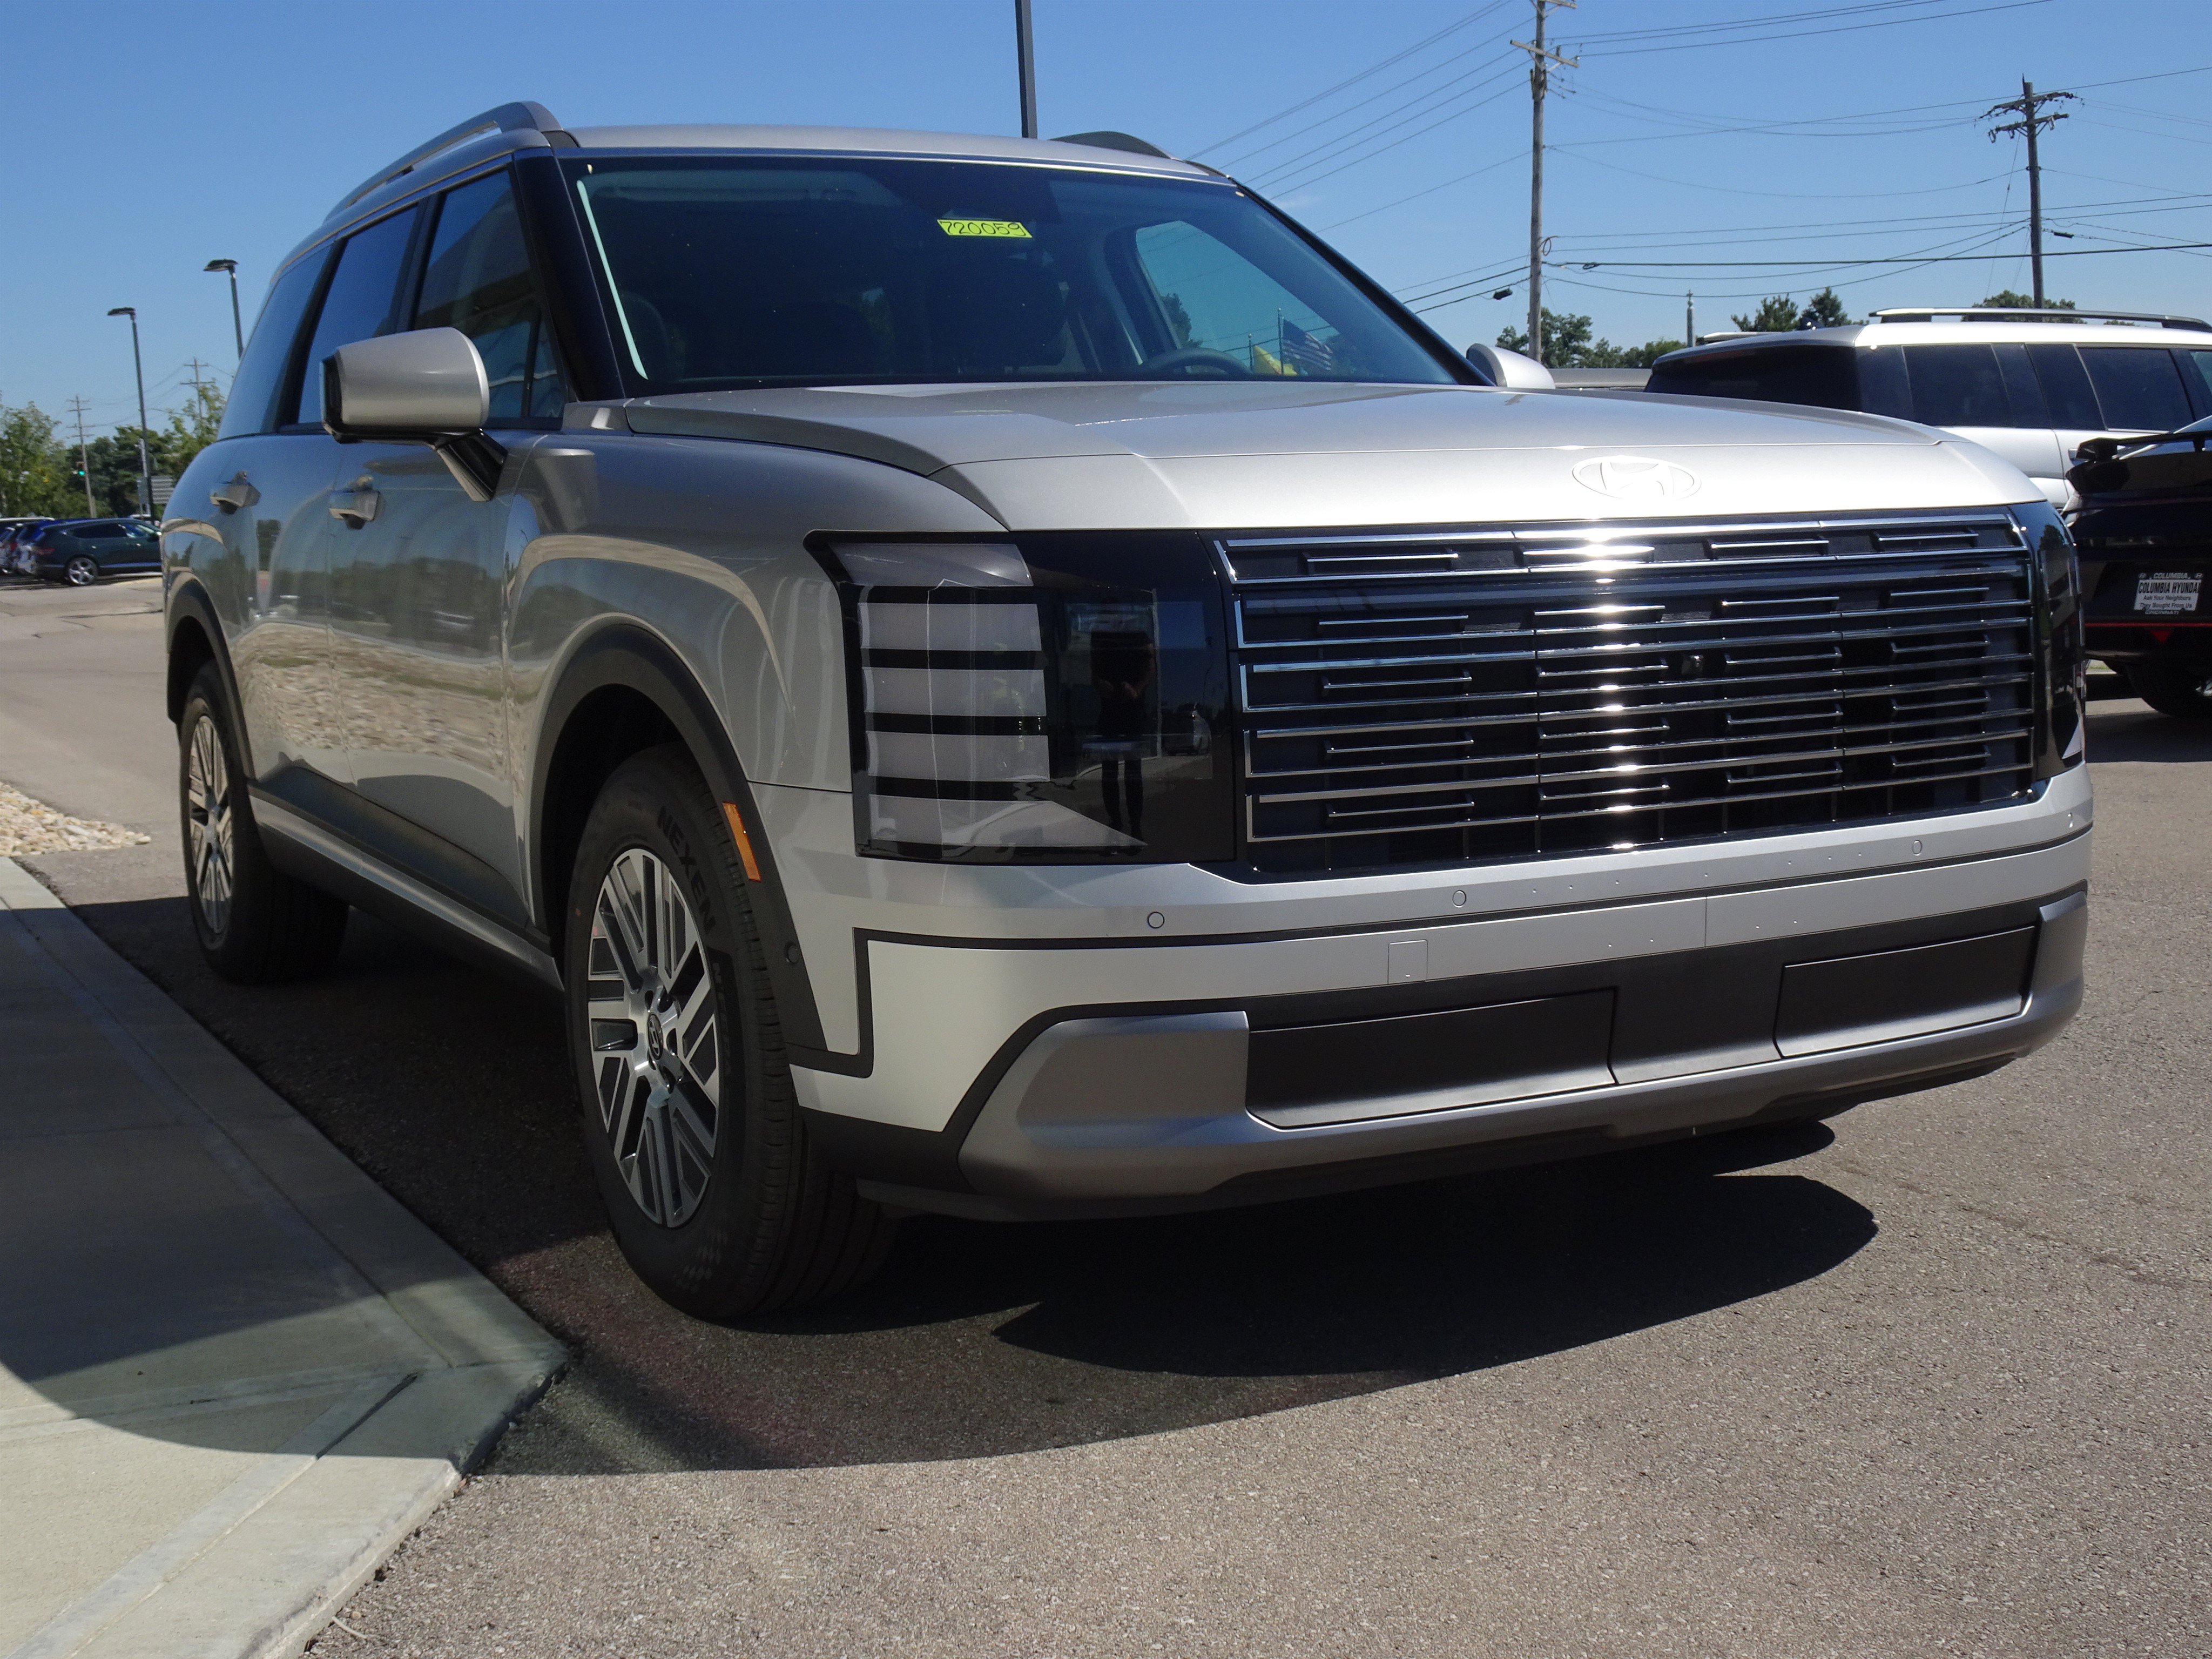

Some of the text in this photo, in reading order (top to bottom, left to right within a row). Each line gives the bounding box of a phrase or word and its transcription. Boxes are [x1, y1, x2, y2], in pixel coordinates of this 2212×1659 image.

[940, 221, 1026, 236] 720059
[2139, 583, 2170, 593] COLUMBIA
[657, 806, 717, 934] NEXEN
